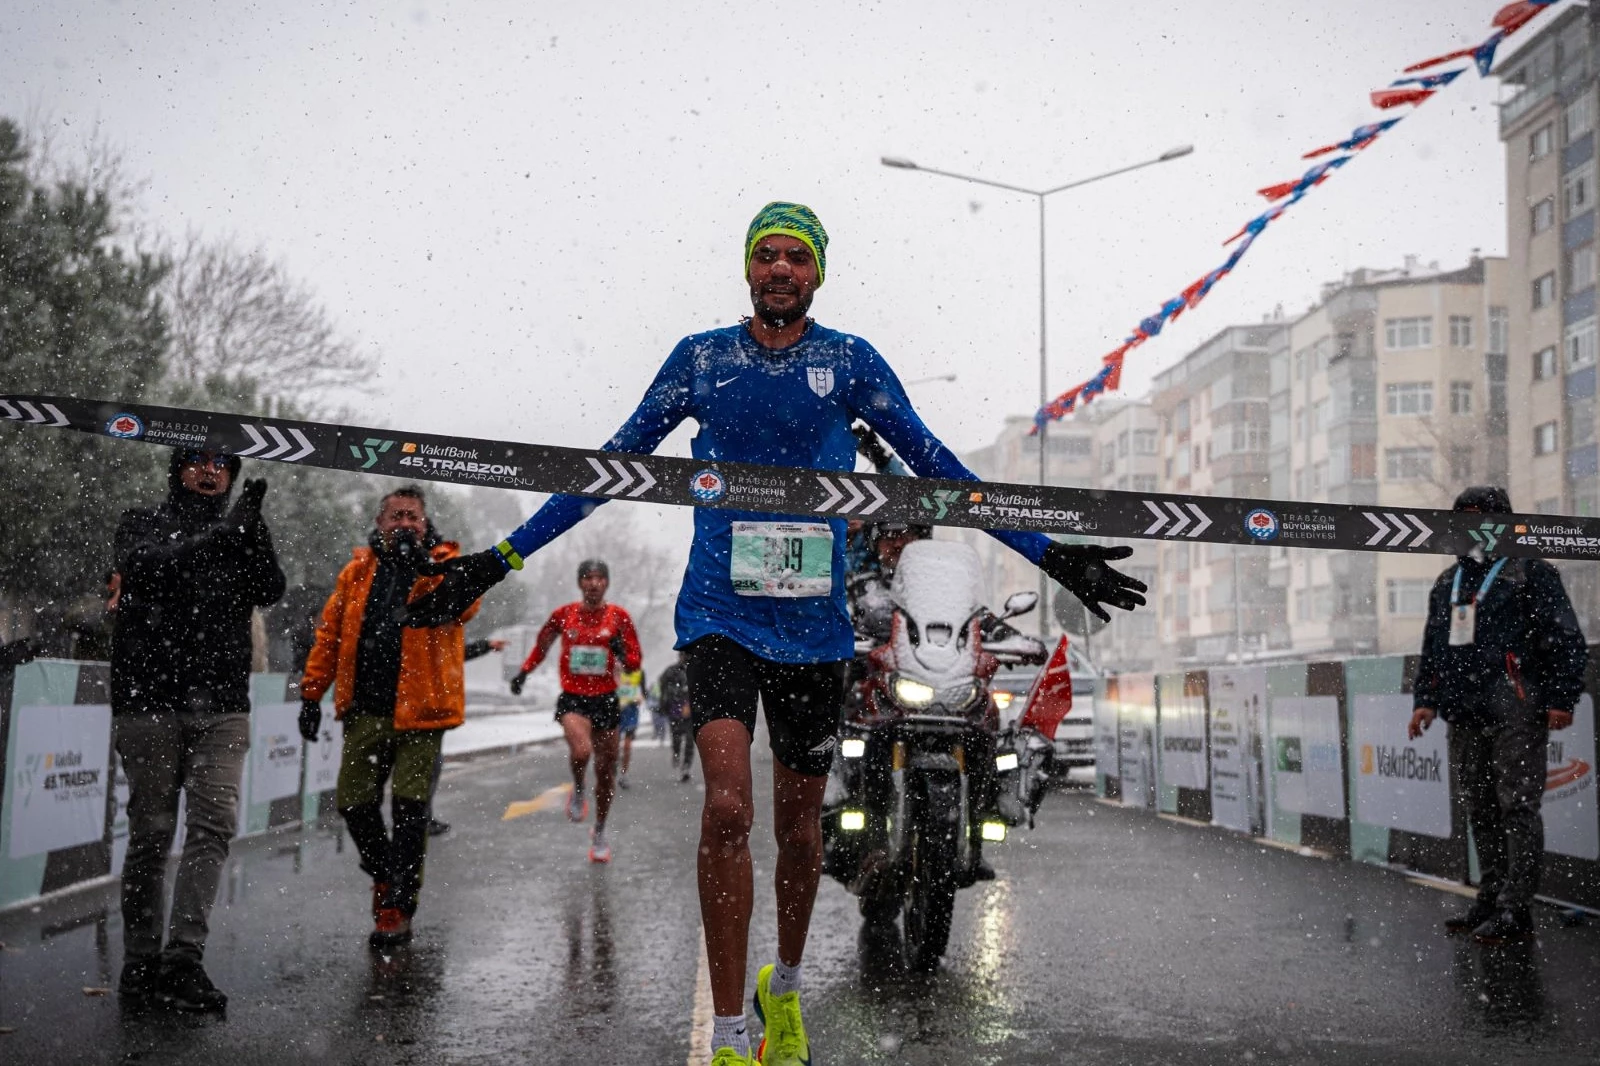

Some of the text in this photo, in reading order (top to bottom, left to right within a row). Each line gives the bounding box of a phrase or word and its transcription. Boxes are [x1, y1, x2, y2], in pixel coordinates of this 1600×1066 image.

[151, 420, 208, 433] TRABZON
[420, 444, 478, 460] VakıfBank
[420, 468, 535, 486] YARI MARATONU
[731, 475, 786, 487] TRABZON
[985, 491, 1042, 506] VakıfBank
[1282, 513, 1335, 523] TRABZON
[1282, 522, 1336, 532] BÜYÜKŞEHİR
[1530, 524, 1583, 535] VakıfBank
[1537, 546, 1567, 554] YARI
[1376, 745, 1442, 782] VakıfBank
